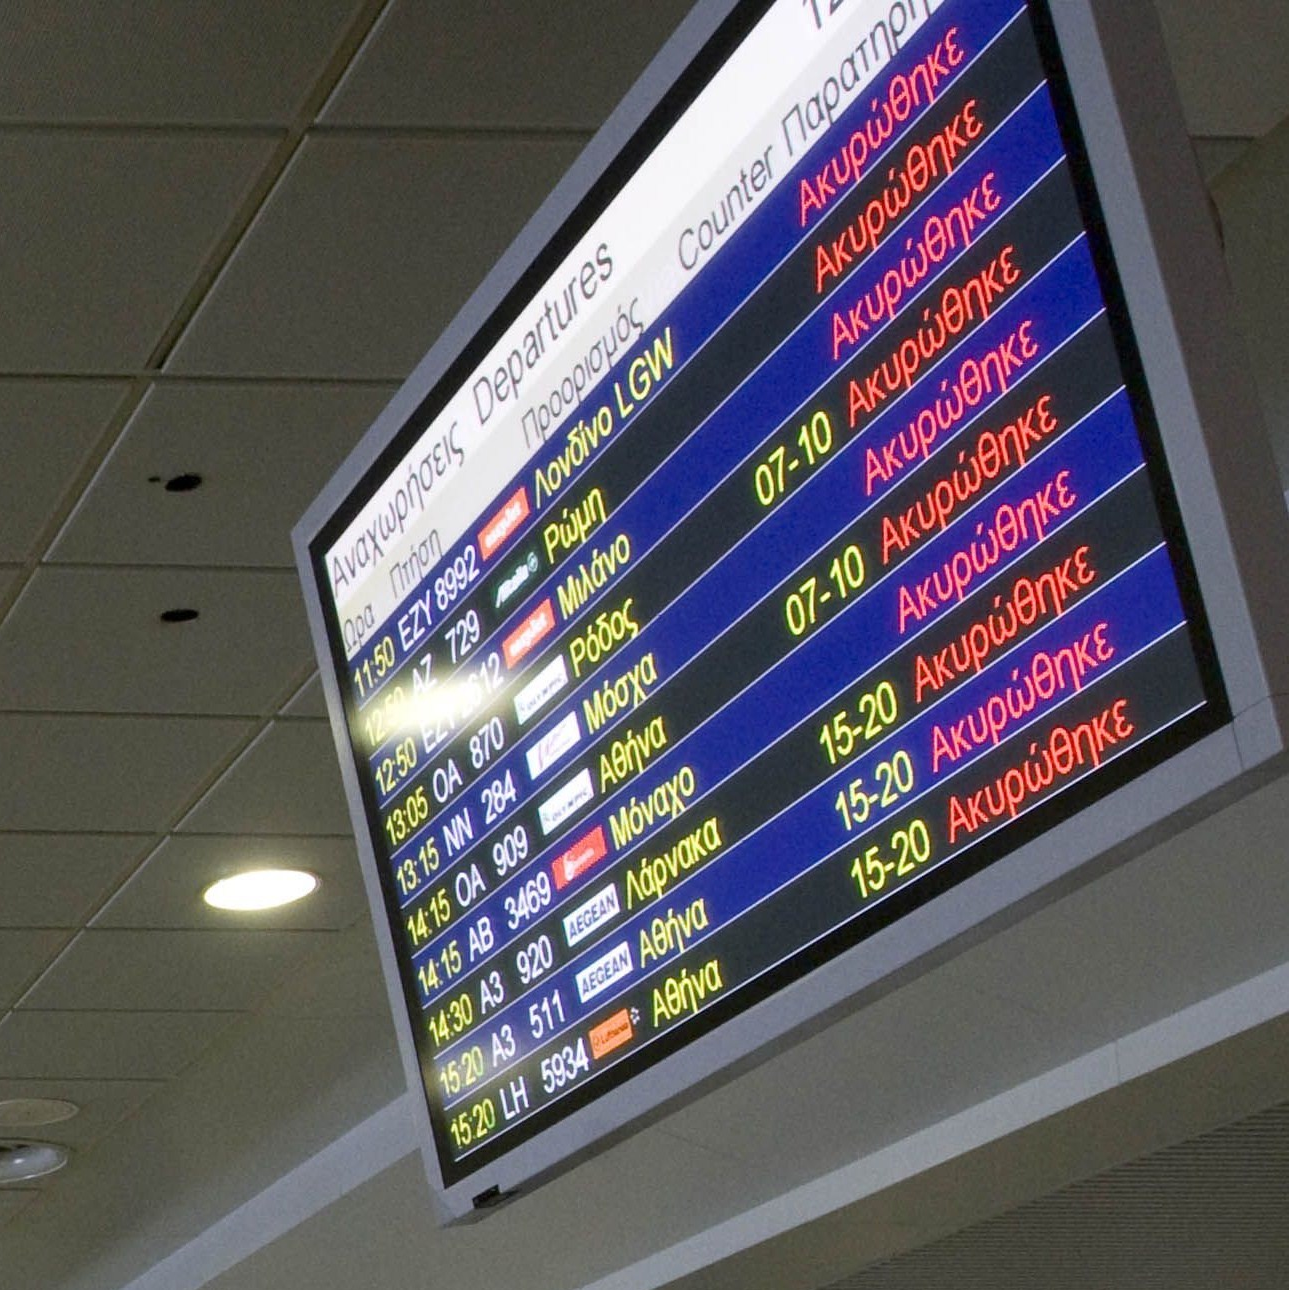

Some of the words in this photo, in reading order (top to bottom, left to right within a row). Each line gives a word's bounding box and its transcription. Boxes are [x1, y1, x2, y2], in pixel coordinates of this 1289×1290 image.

[332, 421, 465, 598] Αναχωρήσεις
[472, 241, 614, 426] Departures
[343, 606, 375, 652] Ωρα
[390, 529, 443, 599] Πτήση
[521, 297, 645, 449] Προορισμός
[678, 145, 773, 271] Counter
[353, 636, 395, 698] 11:50
[397, 590, 434, 652] EZY
[435, 544, 480, 612] 8992
[535, 406, 613, 509] Λονδίνο
[613, 326, 675, 419] LGW
[800, 27, 964, 227] Ακυρώθηκε
[375, 736, 418, 797] 12:50
[557, 533, 630, 620] Μιλάνο
[831, 172, 1002, 360] Ακυρώθηκε
[386, 786, 429, 846] 13:05
[432, 758, 463, 803] OA
[469, 716, 505, 770] 870
[570, 598, 639, 677] Ρόδος
[753, 410, 833, 506] 07-10
[847, 244, 1021, 428] Ακυρώθηκε
[397, 837, 439, 896] 13:15
[442, 807, 474, 857] NN
[481, 769, 517, 825] 284
[583, 652, 658, 735] Μόσχα
[864, 320, 1039, 496] Ακυρώθηκε
[444, 609, 481, 664] 729
[544, 487, 607, 564] Ρώμη
[815, 99, 982, 294] Ακυρώθηκε
[407, 888, 451, 946] 14:15
[455, 863, 487, 907] OA
[492, 825, 529, 876] 909
[599, 715, 667, 794] Αθήνα
[784, 545, 866, 636] 07-10
[881, 395, 1058, 565] Ακυρώθηκε
[418, 939, 462, 997] 14:15
[468, 916, 494, 962] AB
[504, 870, 552, 931] 3469
[608, 766, 696, 851] Μόναχο
[897, 470, 1077, 634] Ακυρώθηκε
[428, 992, 473, 1048] 14:30
[480, 970, 504, 1014] A3
[516, 934, 554, 984] 920
[569, 891, 616, 939] AEGEAN
[625, 817, 723, 911] Λάρνακα
[819, 681, 899, 765] 15-20
[914, 546, 1096, 704] Ακυρώθηκε
[440, 1046, 484, 1098] 15:20
[492, 1024, 516, 1068] A3
[528, 988, 566, 1039] 511
[582, 950, 629, 996] AEGEAN
[639, 897, 710, 969] Αθήνα
[834, 749, 914, 832] 15-20
[931, 622, 1114, 773] Ακυρώθηκε
[450, 1098, 496, 1150] 15:20
[499, 1075, 530, 1121] LH
[540, 1037, 590, 1094] 5934
[652, 959, 723, 1028] Αθήνα
[850, 818, 931, 899] 15-20
[948, 699, 1135, 844] Ακυρώθηκε
